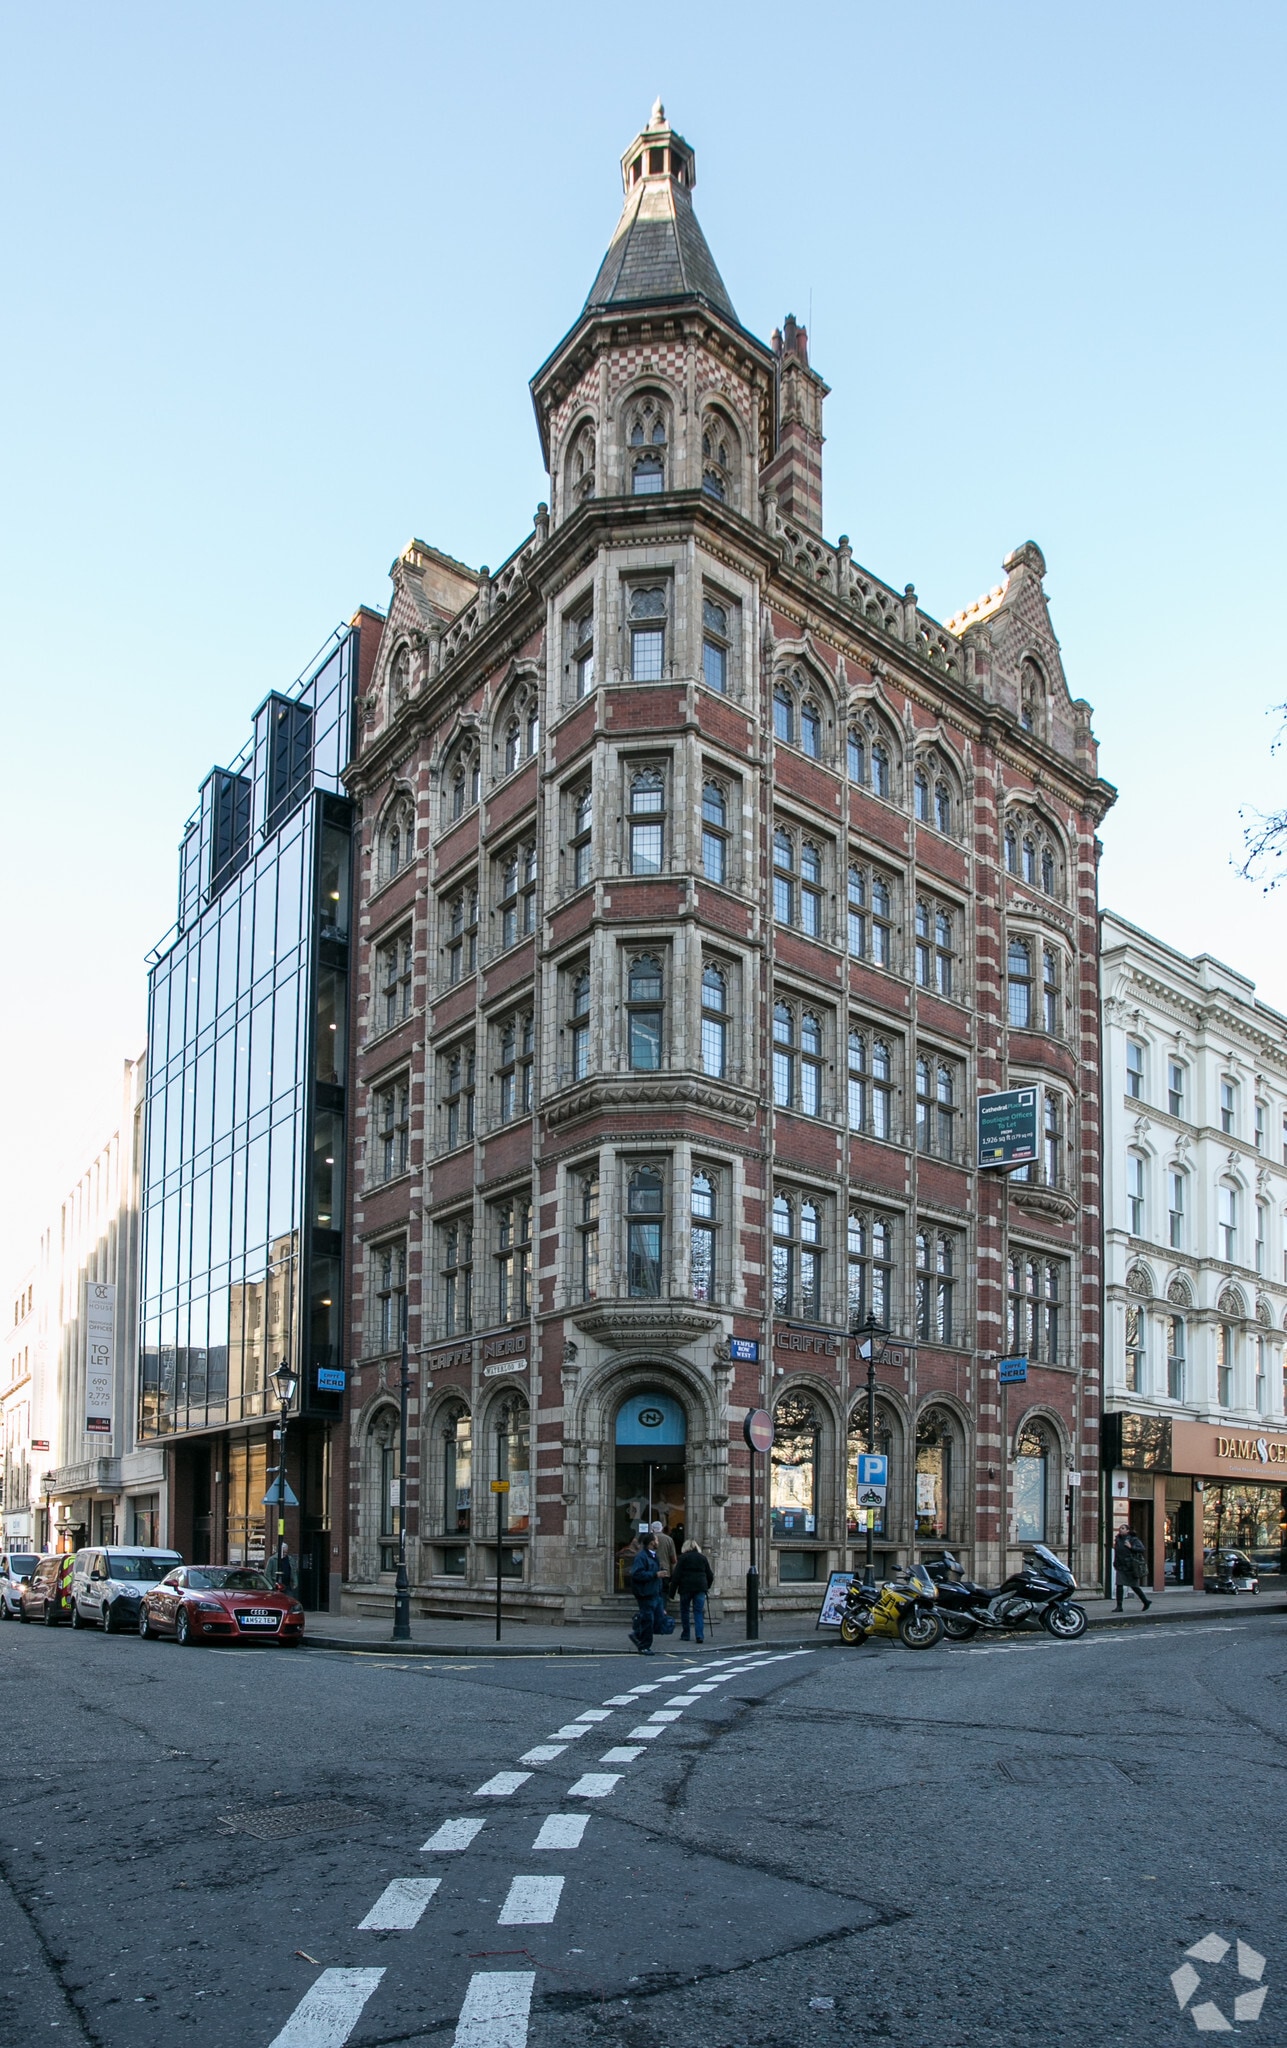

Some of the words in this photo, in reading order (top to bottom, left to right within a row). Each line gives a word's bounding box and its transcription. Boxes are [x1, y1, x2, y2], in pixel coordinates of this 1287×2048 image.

[981, 1115, 1010, 1126] Boutique
[1011, 1111, 1033, 1120] Offices
[92, 1343, 109, 1355] TO
[484, 1335, 526, 1360] NERO
[733, 1339, 755, 1349] TEMPLE
[90, 1355, 110, 1366] LET
[736, 1351, 752, 1359] WEST
[487, 1363, 515, 1375] WATERLOO
[1000, 1369, 1025, 1378] NERO
[92, 1378, 108, 1386] 690
[320, 1378, 344, 1387] NERO
[88, 1391, 110, 1401] 2,775
[1218, 1436, 1287, 1464] DAMASCE
[864, 1457, 883, 1483] P
